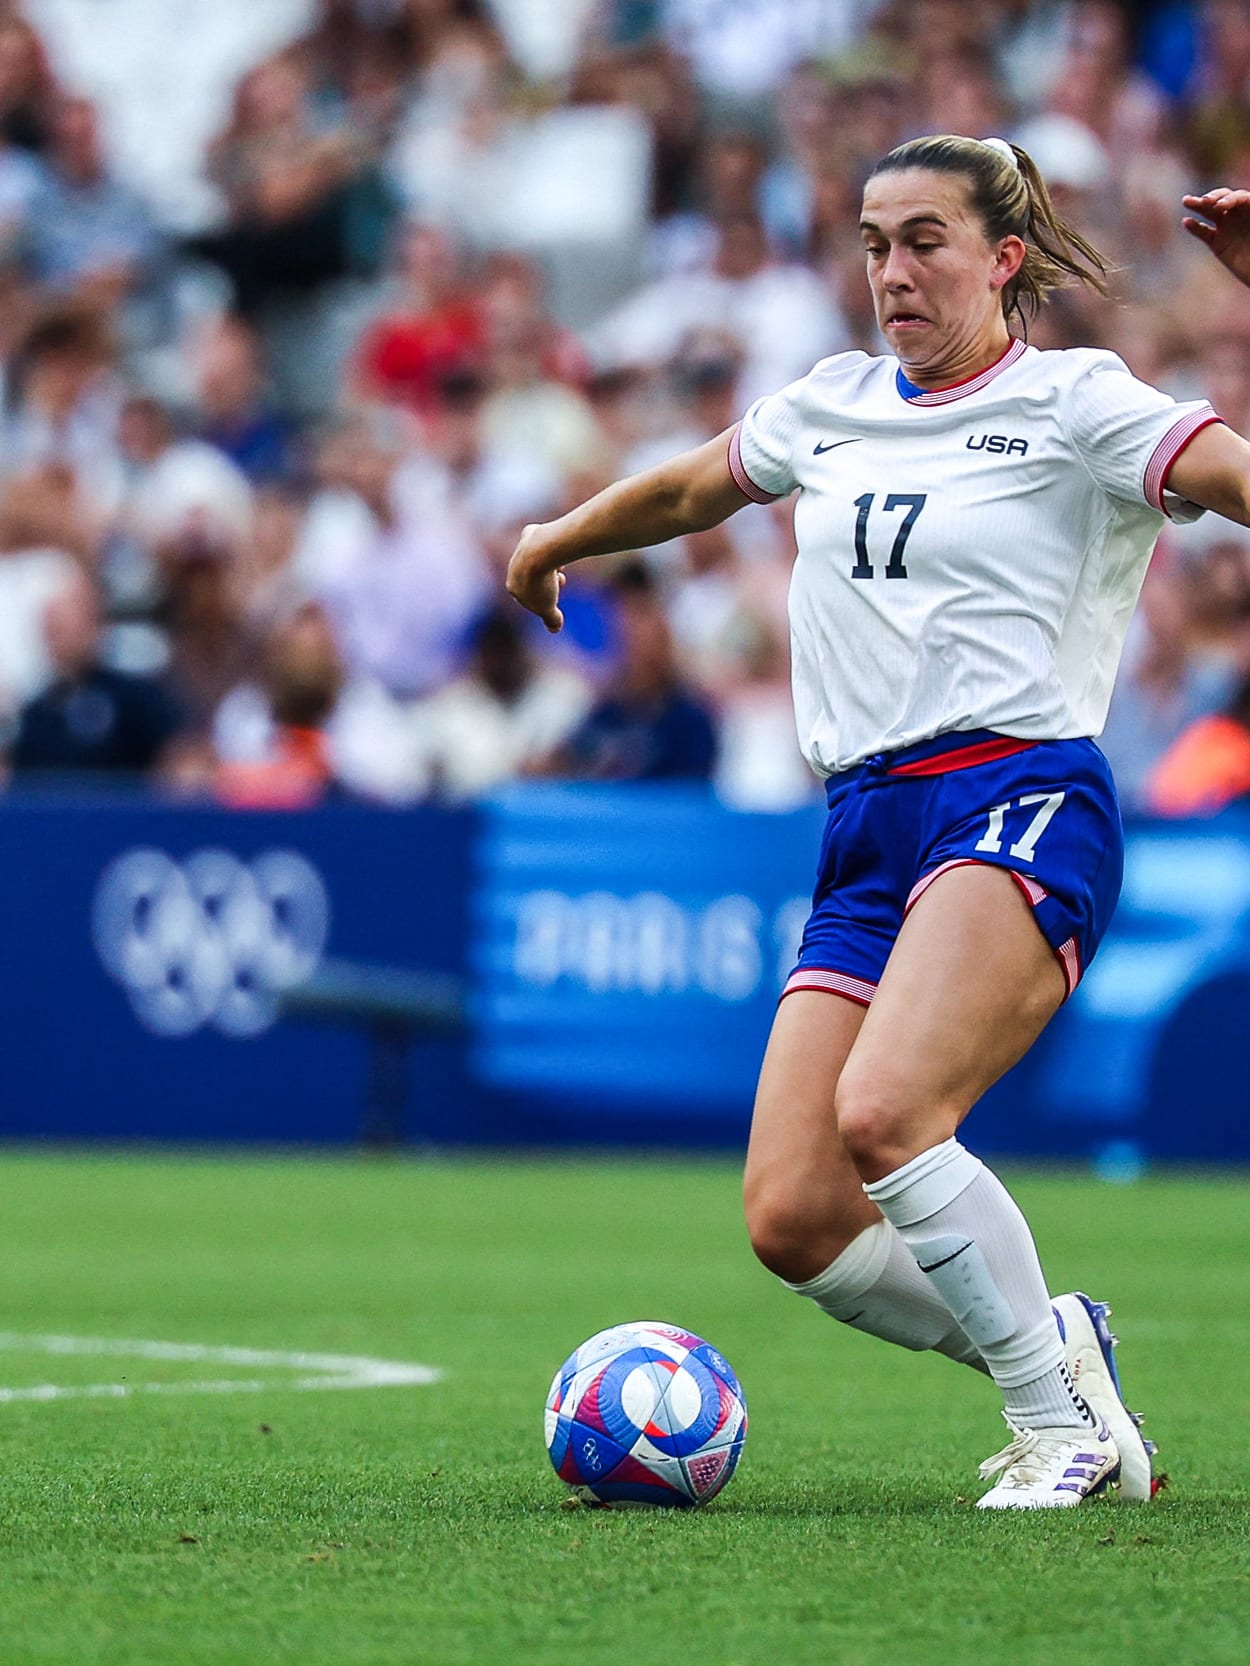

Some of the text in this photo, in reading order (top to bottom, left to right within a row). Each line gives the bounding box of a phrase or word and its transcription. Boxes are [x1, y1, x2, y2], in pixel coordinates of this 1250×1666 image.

[966, 434, 1029, 456] USA
[851, 492, 928, 579] 17
[974, 791, 1066, 863] 17
